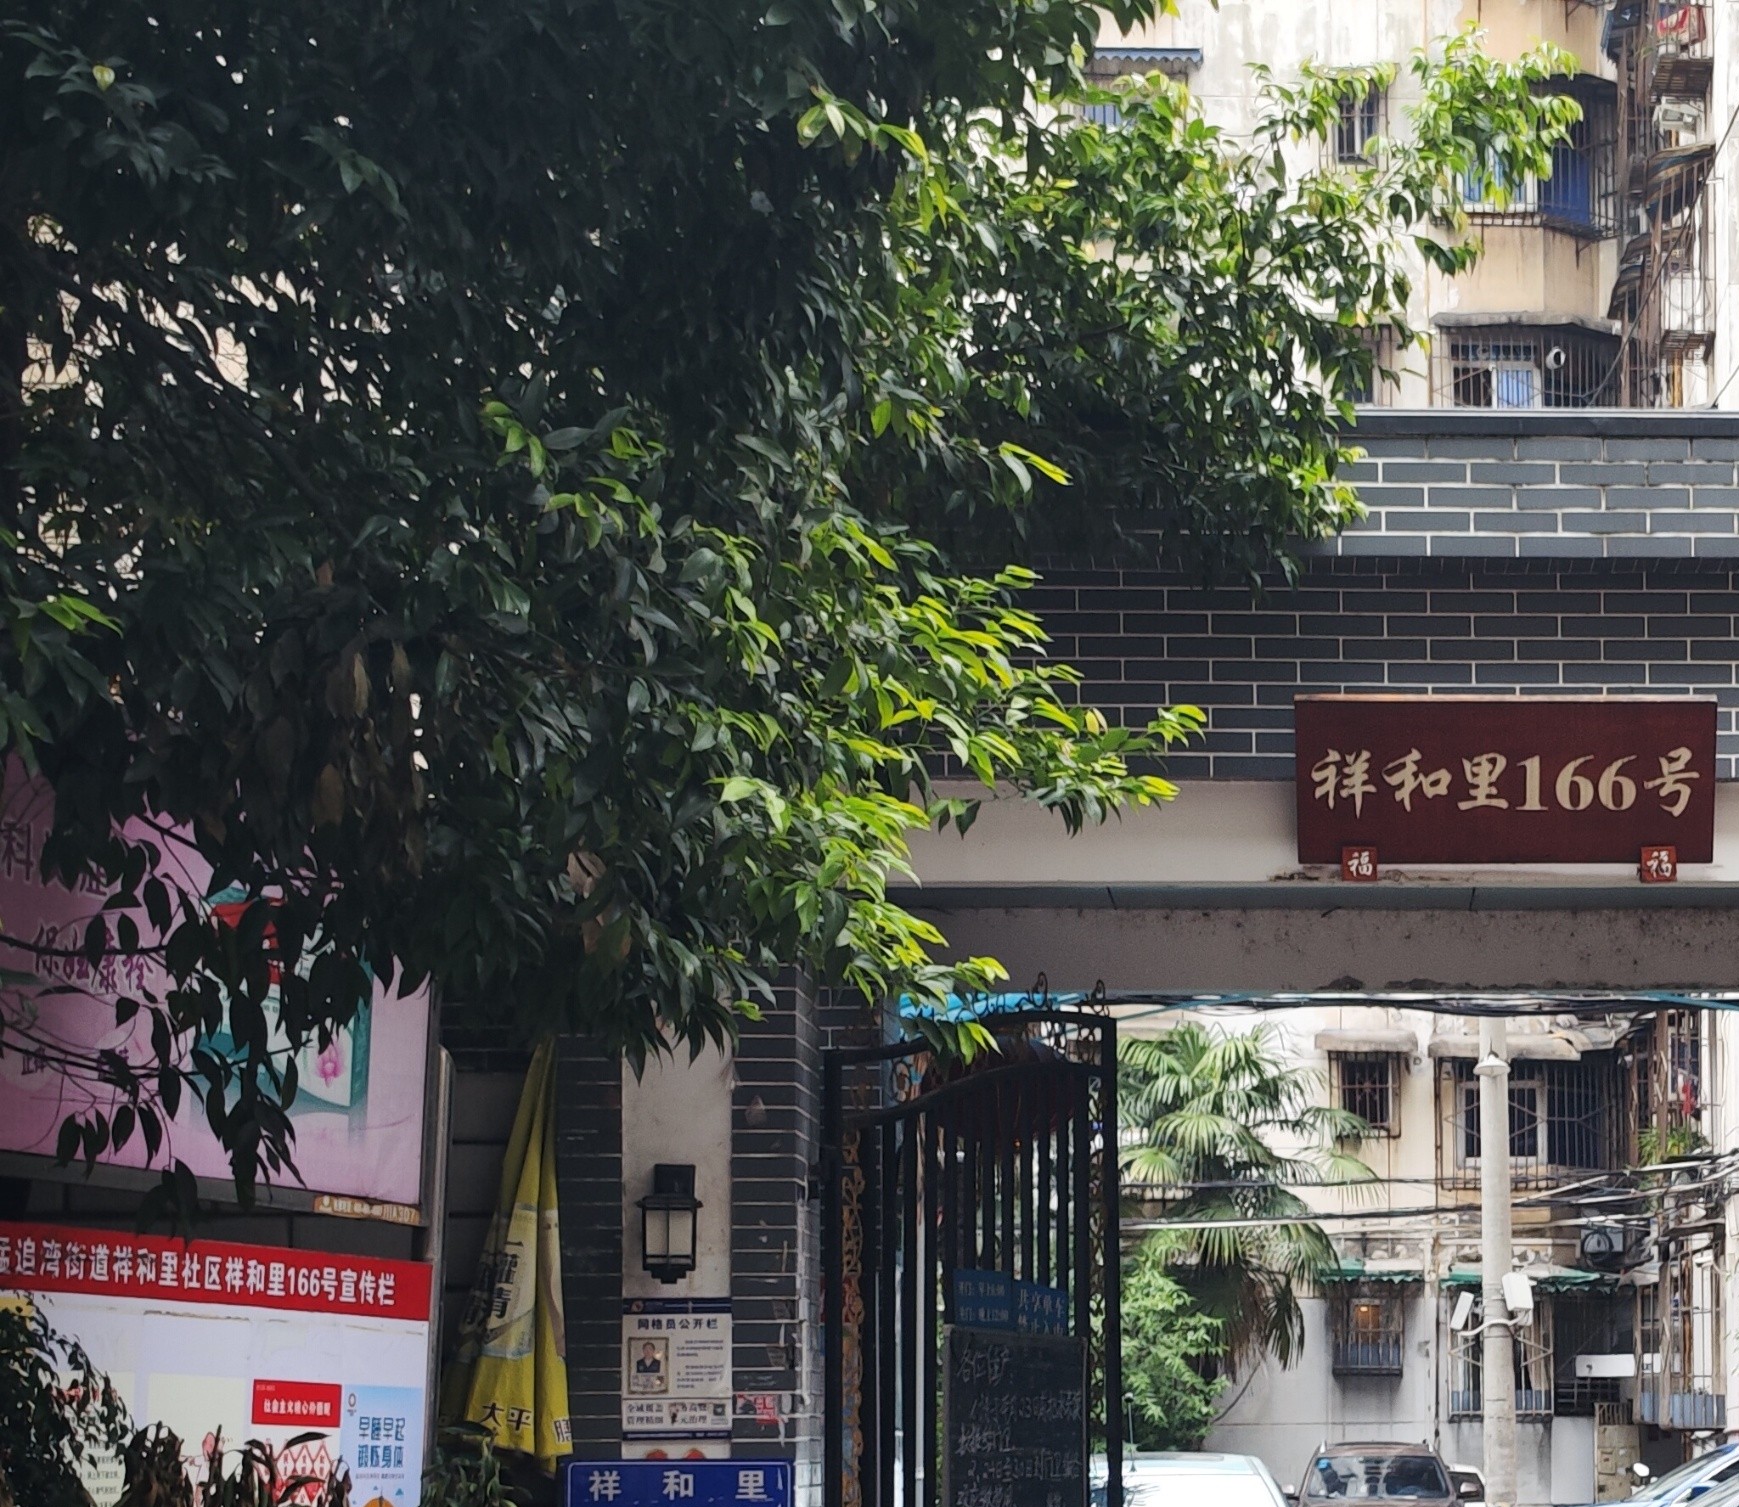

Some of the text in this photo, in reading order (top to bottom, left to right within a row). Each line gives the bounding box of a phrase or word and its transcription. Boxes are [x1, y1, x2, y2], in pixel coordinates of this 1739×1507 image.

[1311, 746, 1700, 819] 祥和里166号
[1347, 849, 1374, 879] 福
[1646, 849, 1673, 879] 福
[359, 1416, 406, 1441] 早睡早起
[357, 1444, 405, 1468] 锻炼身体
[588, 1470, 767, 1501] 祥和里
